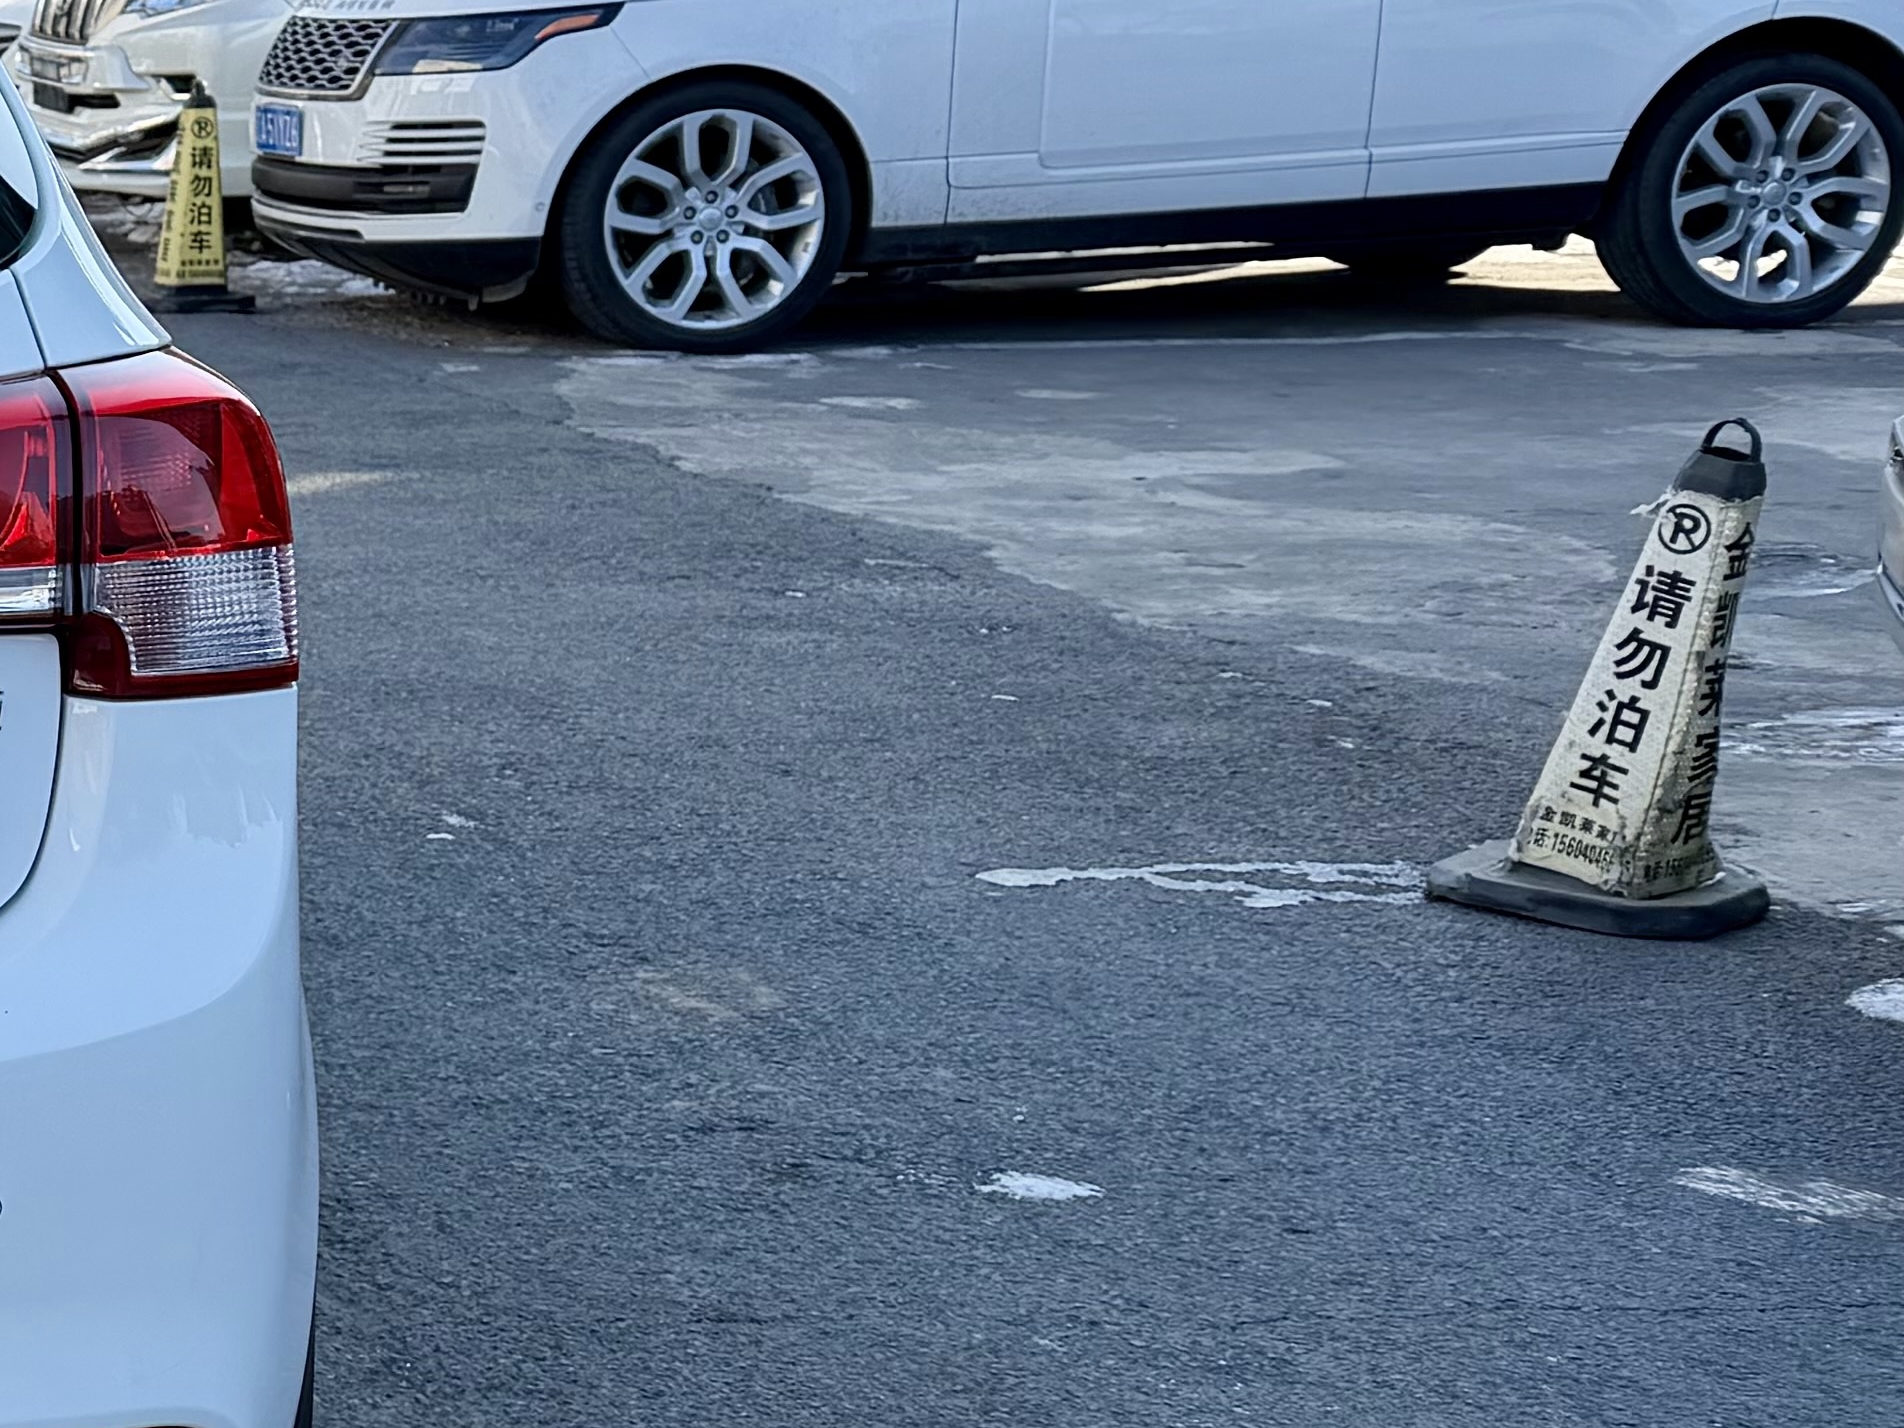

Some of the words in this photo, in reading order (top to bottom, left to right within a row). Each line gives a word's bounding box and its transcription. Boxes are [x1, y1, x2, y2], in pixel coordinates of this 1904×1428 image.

[188, 145, 214, 255] 请勿泊车
[1569, 564, 1697, 808] 请勿泊车
